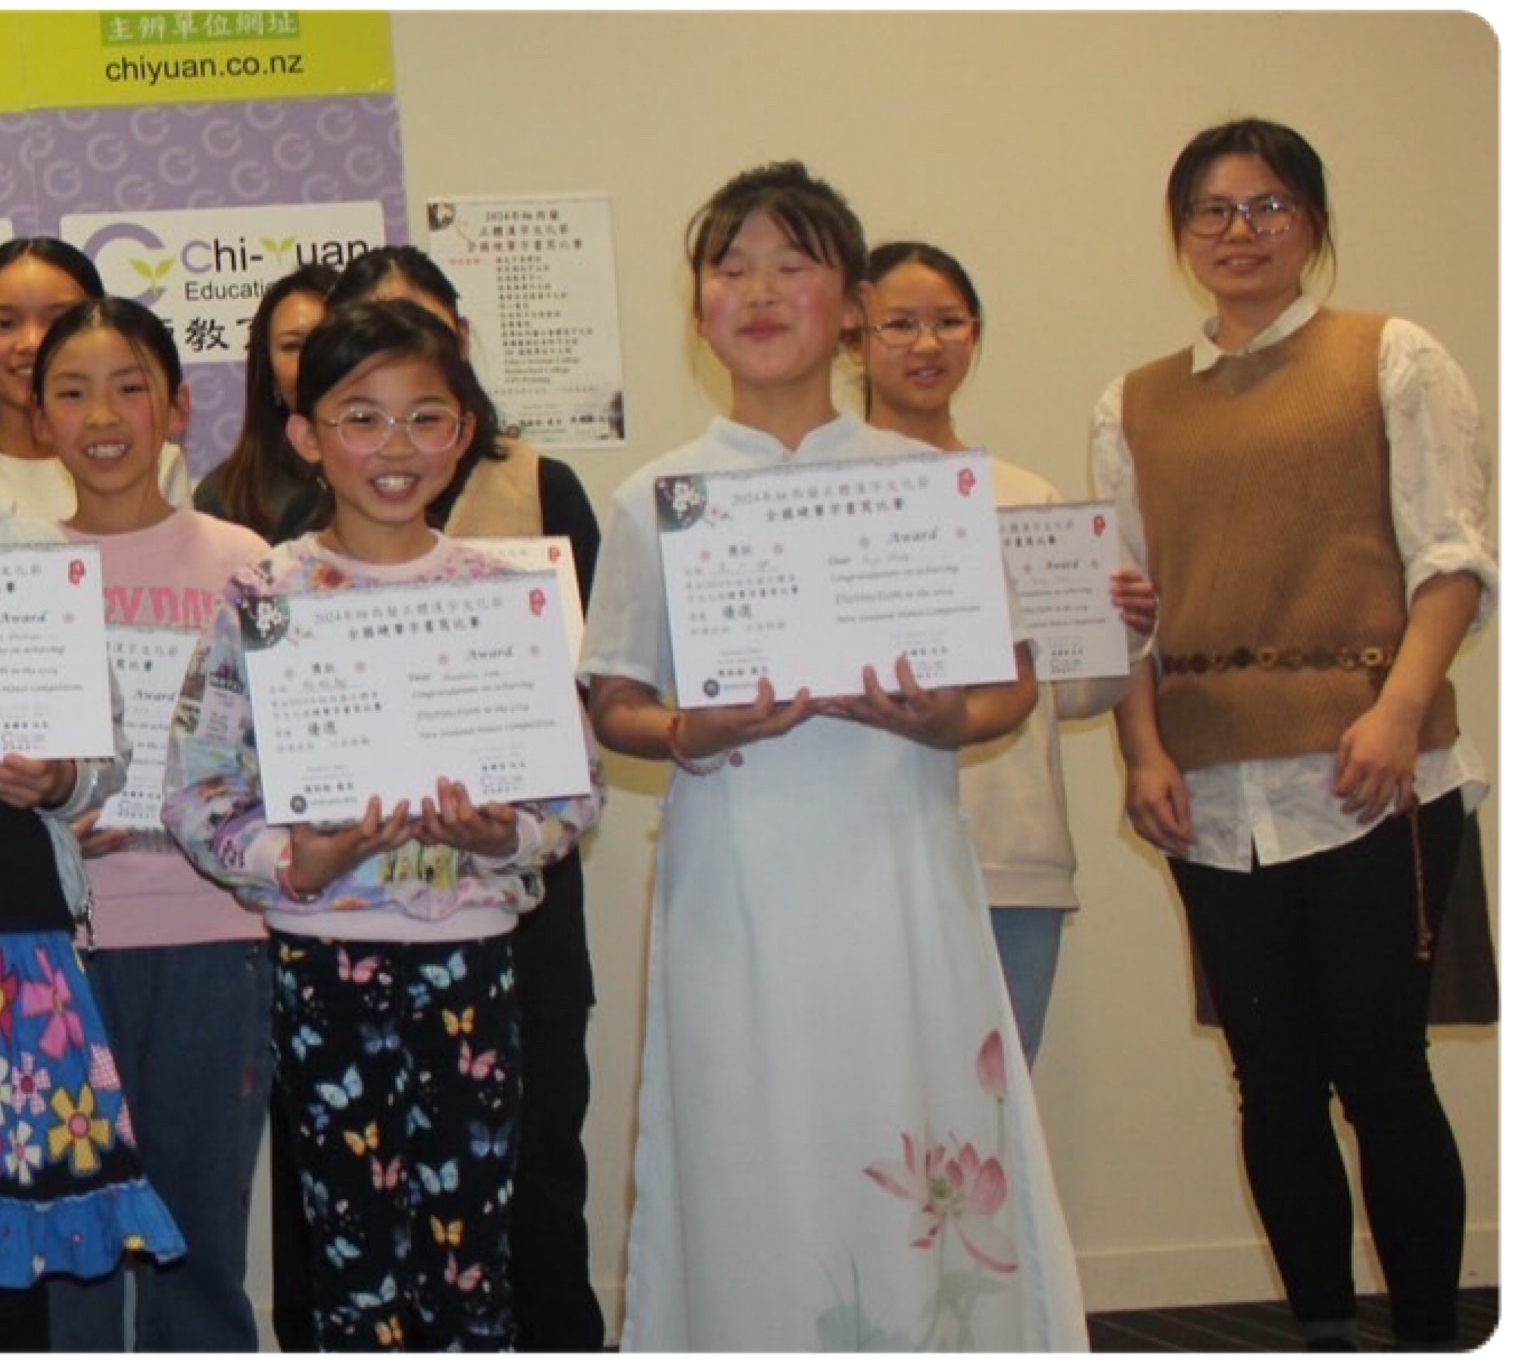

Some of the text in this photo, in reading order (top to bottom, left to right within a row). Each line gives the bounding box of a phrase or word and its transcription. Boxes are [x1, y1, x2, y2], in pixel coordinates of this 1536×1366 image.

[105, 52, 305, 87] chiyuan.co.nz
[181, 236, 370, 274] Chi-Yuan
[185, 280, 269, 302] Educati
[888, 527, 939, 546] Award
[467, 644, 515, 662] Award
